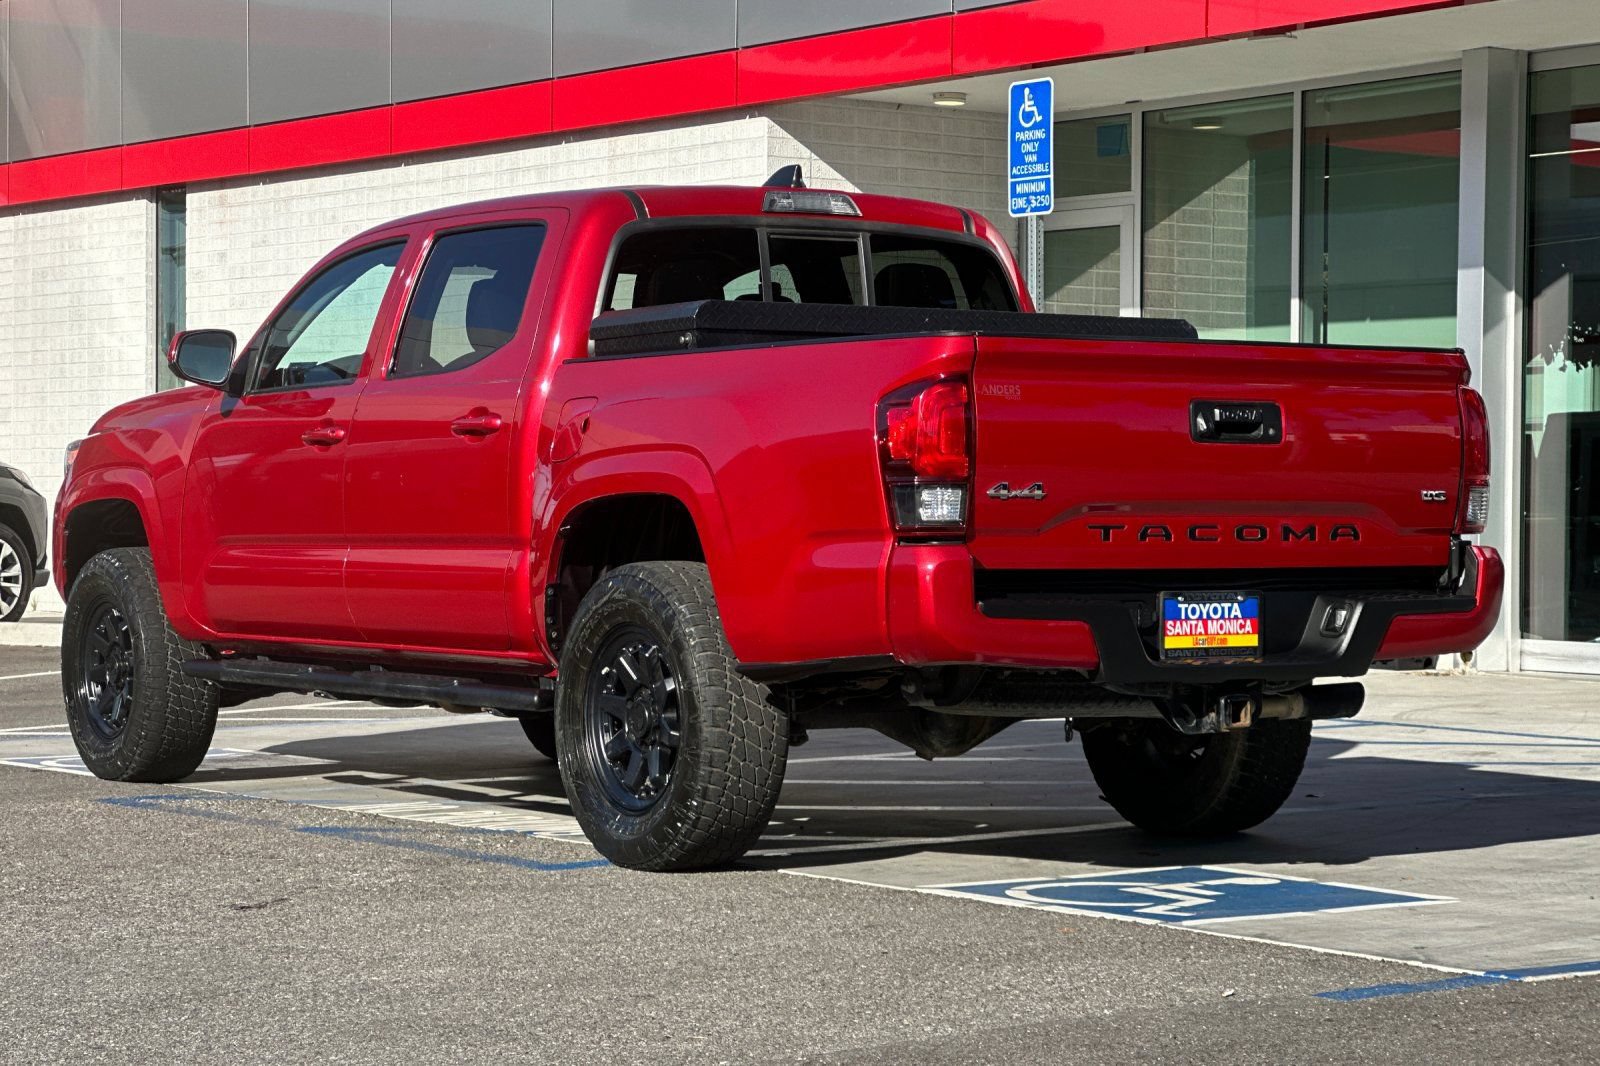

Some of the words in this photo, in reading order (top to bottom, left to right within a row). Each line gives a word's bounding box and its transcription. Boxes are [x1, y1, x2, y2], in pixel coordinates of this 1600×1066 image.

[1015, 129, 1046, 141] PARKING
[1021, 142, 1039, 153] ONLY
[1024, 153, 1037, 163] VAN
[1012, 163, 1049, 175] ACCESSIBLE
[1016, 181, 1046, 194] MINIMUM
[1030, 195, 1050, 208] $250
[1086, 523, 1362, 543] TACOMA
[1178, 603, 1242, 619] TOYOTA
[1166, 620, 1205, 635] SANTA
[1207, 619, 1253, 635] MONICA
[1167, 648, 1207, 658] SANTA
